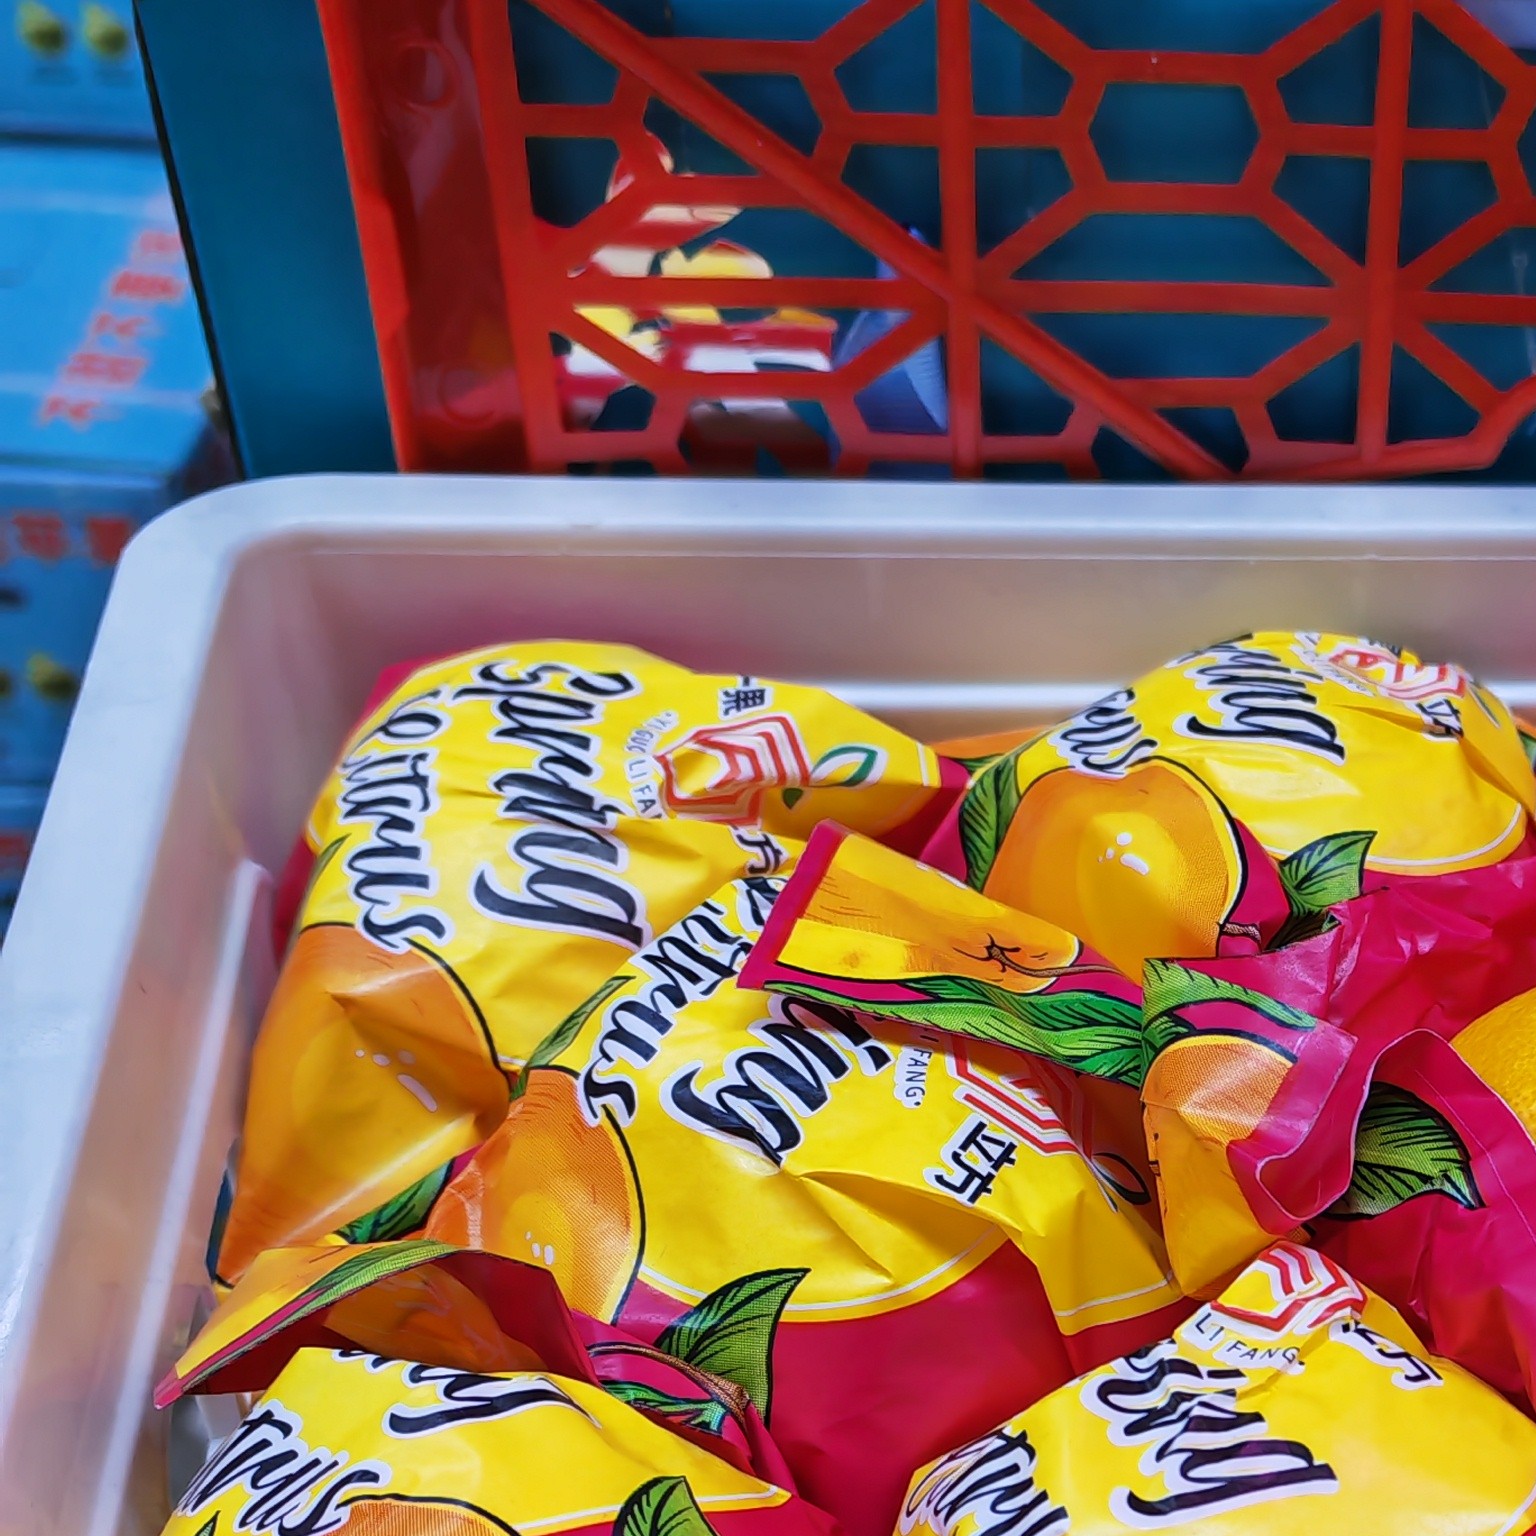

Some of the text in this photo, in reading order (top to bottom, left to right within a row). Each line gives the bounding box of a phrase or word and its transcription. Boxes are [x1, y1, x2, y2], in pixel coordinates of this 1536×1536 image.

[1178, 633, 1345, 760] ring
[628, 759, 648, 780] LI
[452, 664, 643, 948] Spring
[633, 784, 662, 820] FA
[730, 825, 783, 874] 方
[672, 995, 893, 1168] ing
[905, 1048, 933, 1098] FANG
[934, 1121, 1018, 1205] 立方
[1195, 1313, 1300, 1365] LI FANG
